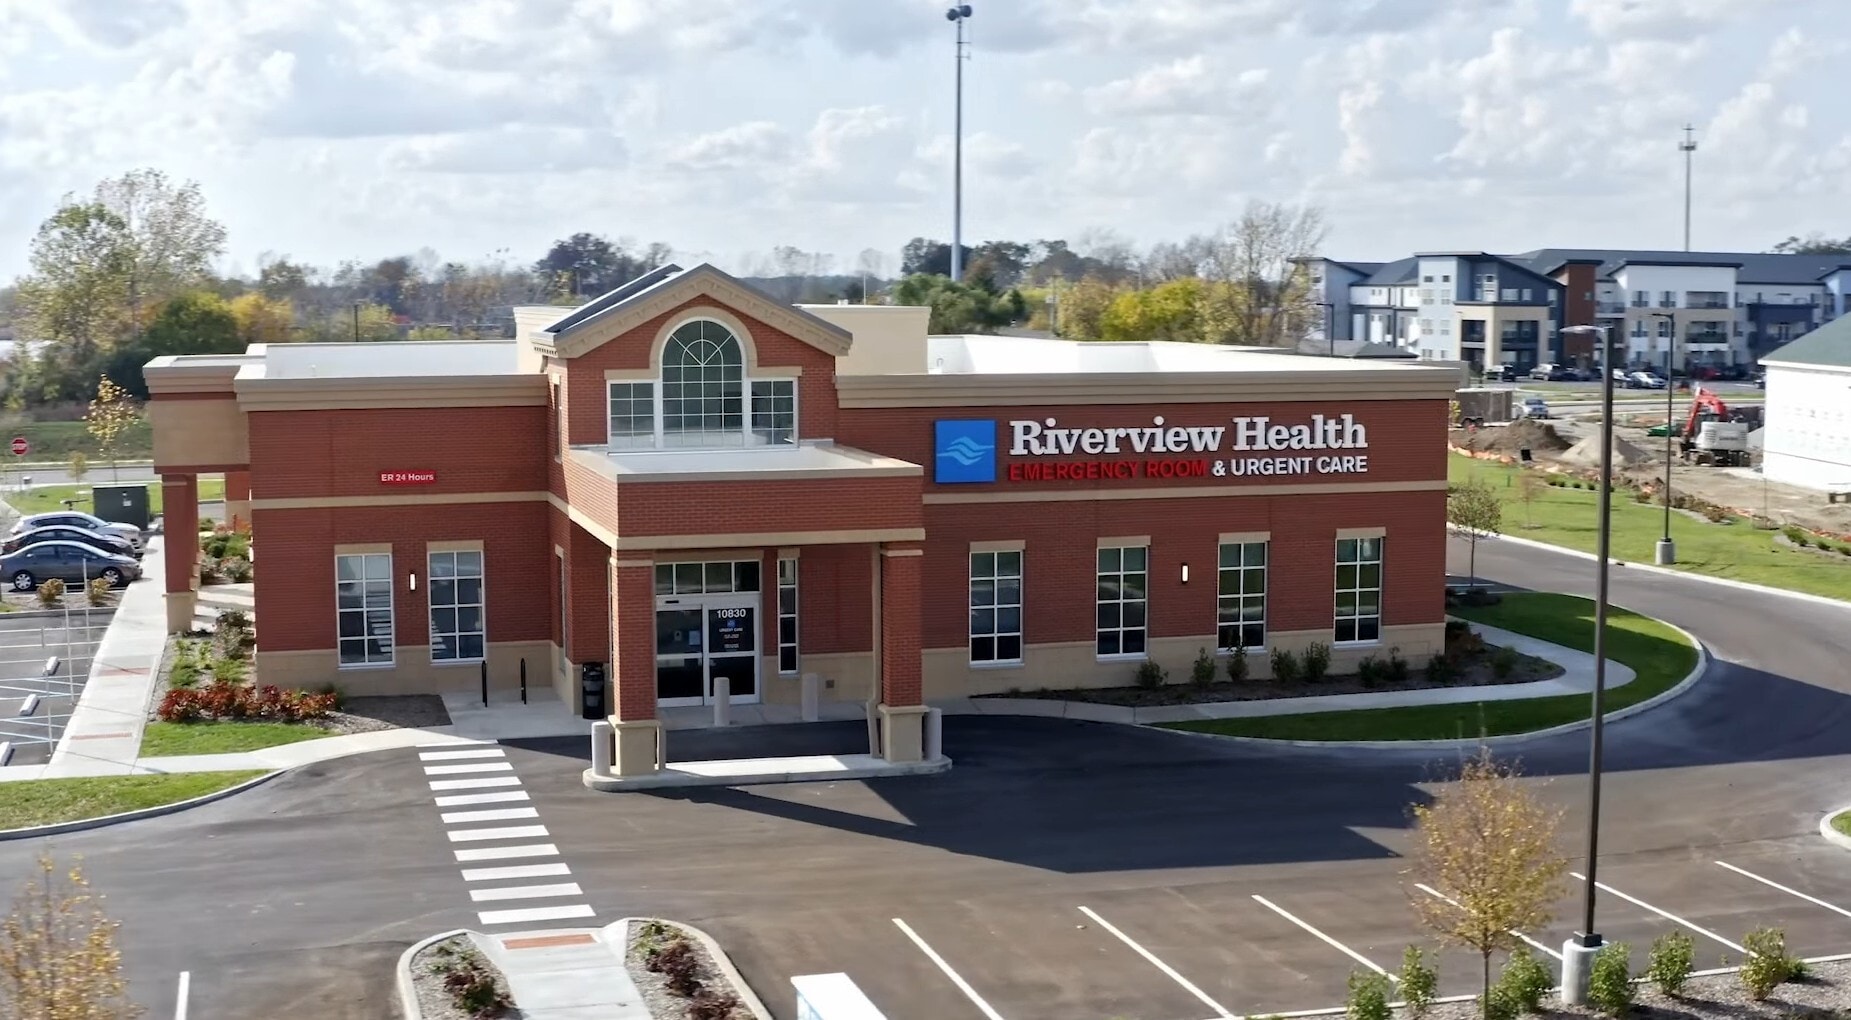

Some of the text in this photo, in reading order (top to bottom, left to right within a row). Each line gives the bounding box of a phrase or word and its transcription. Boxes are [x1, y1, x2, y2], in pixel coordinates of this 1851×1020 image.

[1009, 413, 1369, 456] Riverview Health
[408, 473, 434, 481] Hours
[1009, 455, 1369, 481] EMERGENCY ROOM & URGENT CARE
[717, 608, 746, 618] 10830
